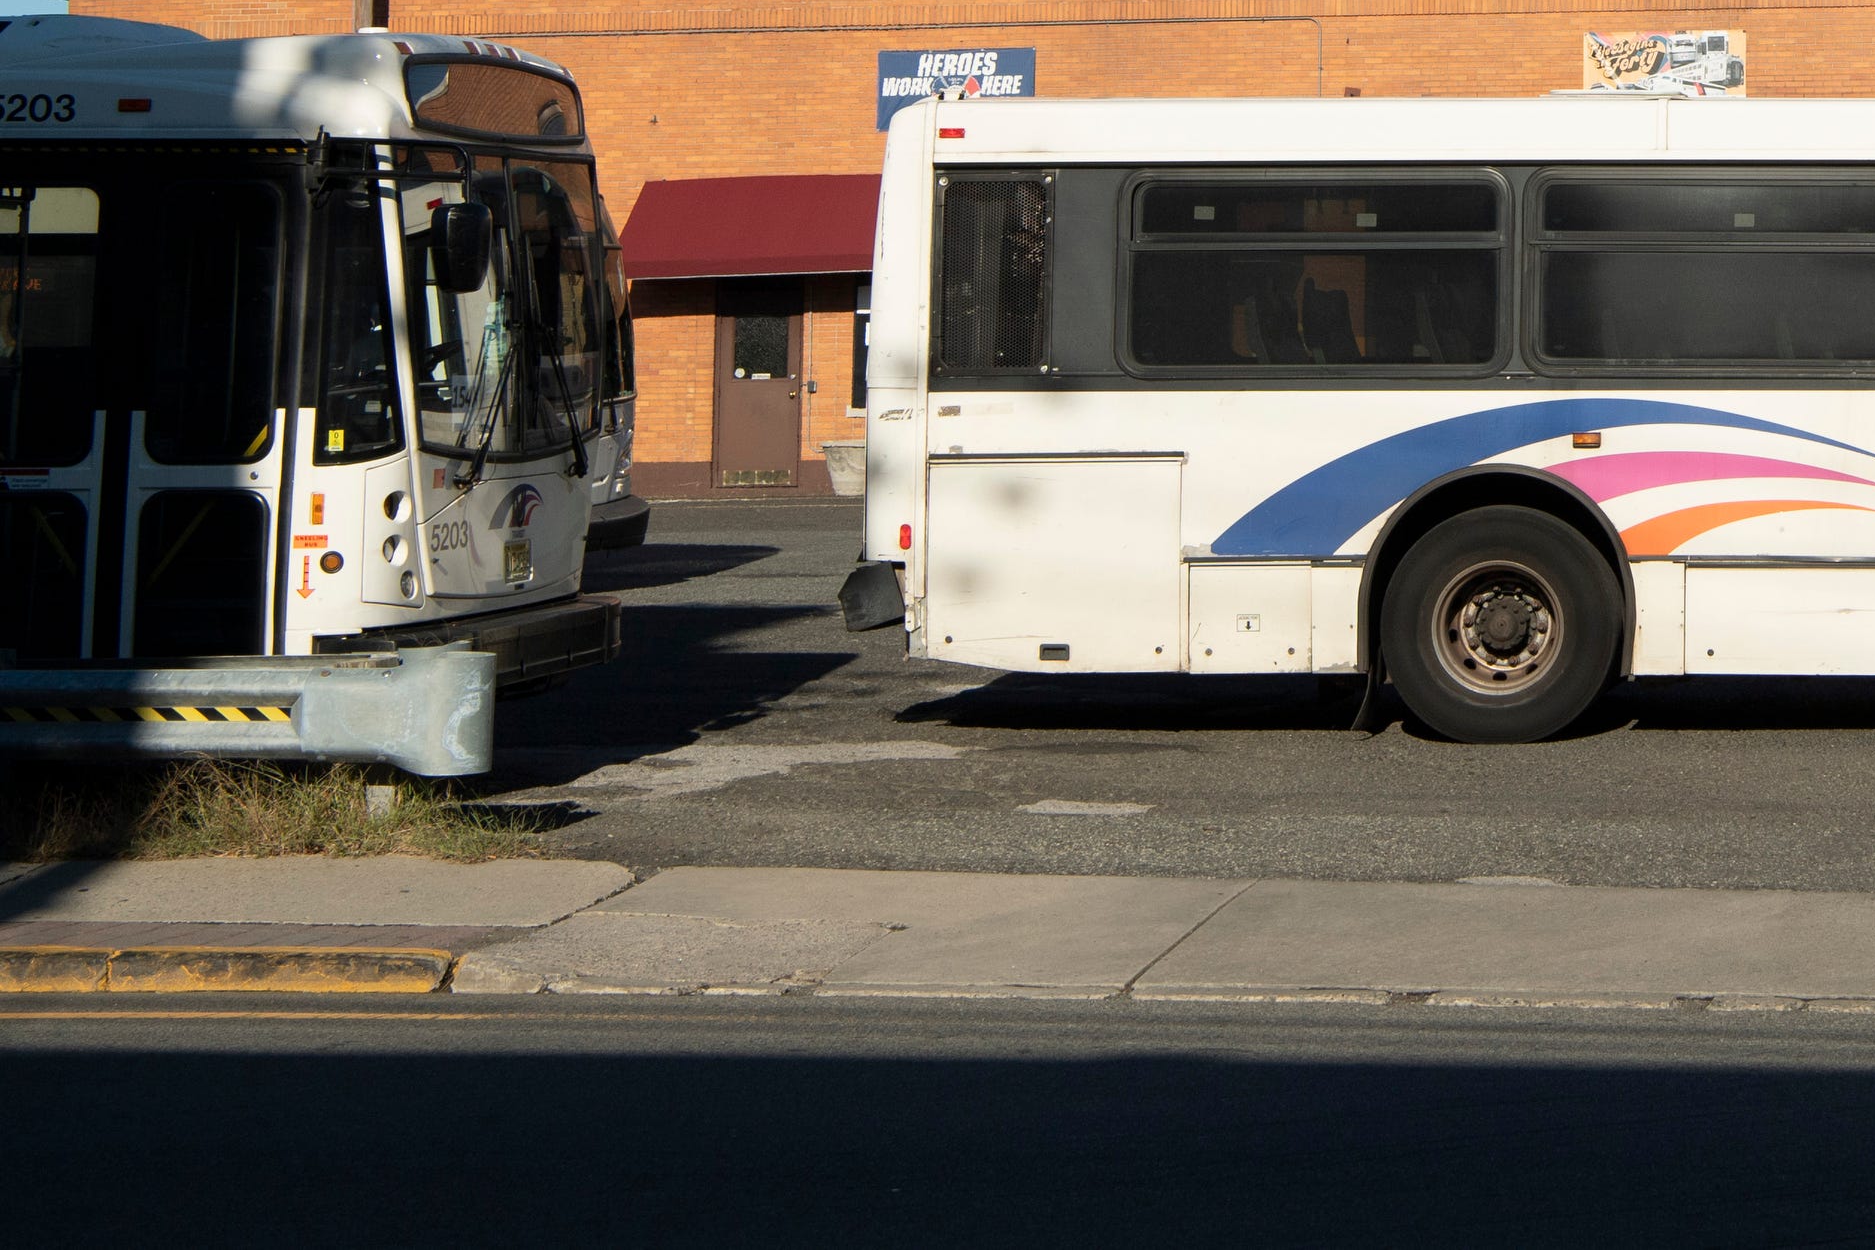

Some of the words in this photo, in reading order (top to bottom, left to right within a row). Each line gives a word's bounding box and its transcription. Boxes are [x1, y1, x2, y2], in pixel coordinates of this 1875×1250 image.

[917, 52, 998, 77] HEROES
[882, 76, 934, 97] WORK
[981, 75, 1023, 96] HERE
[0, 94, 76, 123] 203
[430, 520, 469, 552] 5203
